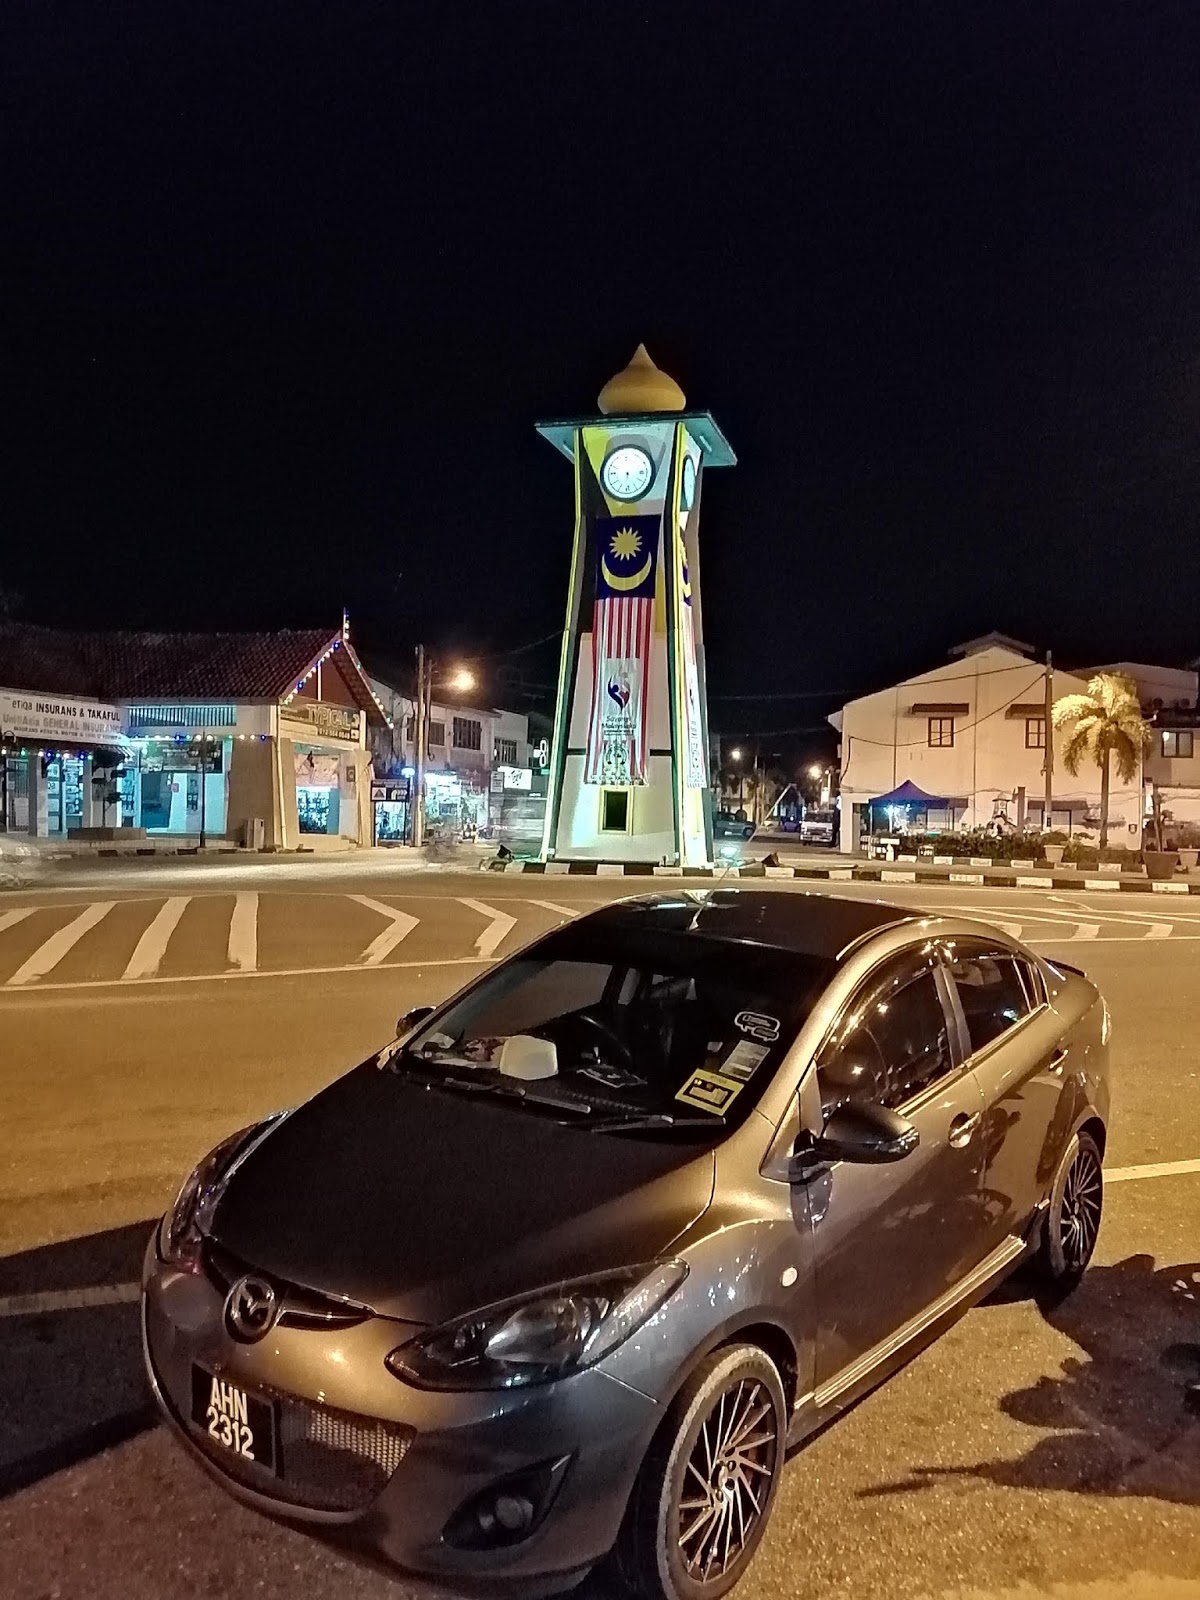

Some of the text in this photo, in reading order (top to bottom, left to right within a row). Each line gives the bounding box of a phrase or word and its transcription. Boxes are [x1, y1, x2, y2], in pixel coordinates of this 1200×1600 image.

[36, 703, 77, 717] INSURANS
[79, 708, 85, 718] &
[87, 709, 121, 722] TAKAFUL
[43, 717, 79, 731] GENERAL
[82, 721, 125, 734] INSURANCE
[306, 704, 350, 730] TYPICAL
[210, 1376, 248, 1426] AHN
[206, 1406, 255, 1460] 2312
